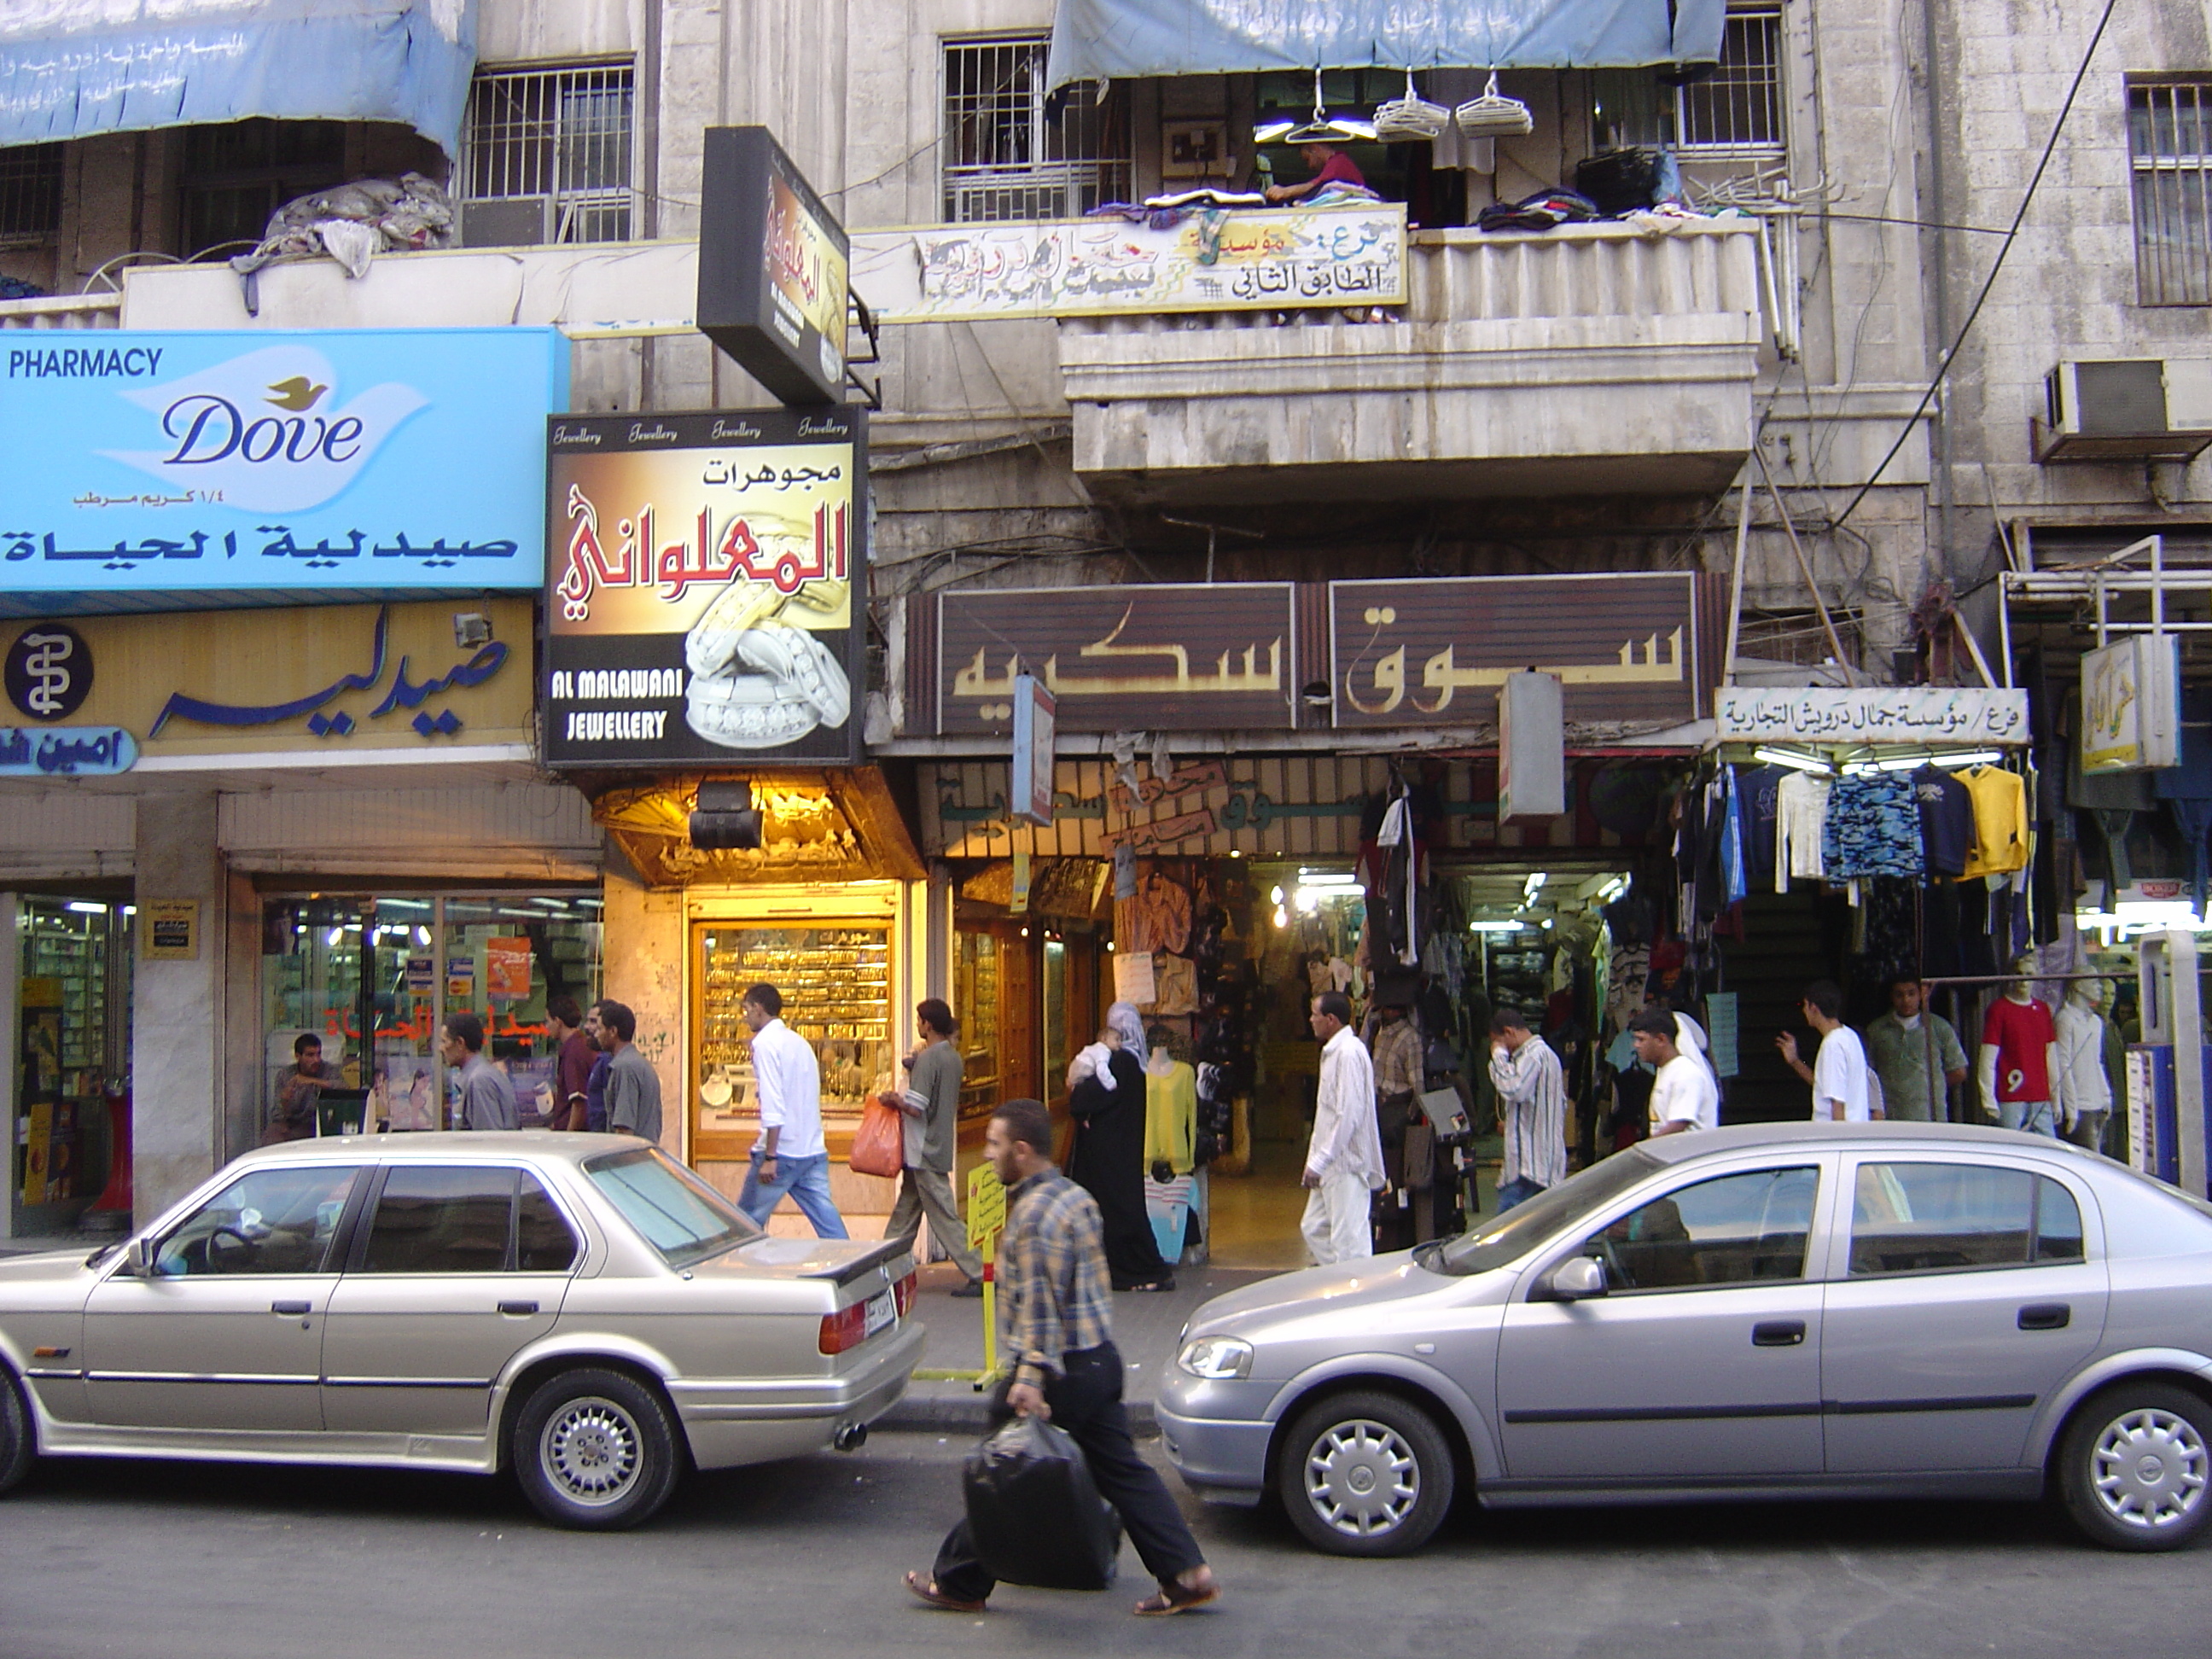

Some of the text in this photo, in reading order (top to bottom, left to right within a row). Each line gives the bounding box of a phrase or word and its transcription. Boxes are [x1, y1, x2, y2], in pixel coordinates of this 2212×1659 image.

[1231, 265, 1382, 300] الطابق الثاني
[9, 348, 162, 378] PHARMACY
[162, 394, 363, 464] Dove
[553, 416, 848, 446] Jewellery Jewellery Jewellery Jewellery
[701, 458, 842, 492] مجوهرات
[73, 492, 138, 509] مرطب
[142, 490, 195, 507] كريم
[2, 525, 519, 571] صيدلية الحياة
[557, 483, 851, 621] المعلواني
[1346, 607, 1684, 713] سوق
[552, 668, 683, 700] AL MALAWANI
[567, 711, 667, 741] JEWELLERY
[1726, 701, 1796, 731] التجارية
[1794, 701, 1851, 734] درويش
[1853, 702, 1896, 731] جمال
[1897, 702, 1968, 734] مؤسسة
[1986, 707, 2020, 736] فرع
[2007, 1068, 2023, 1092] 9
